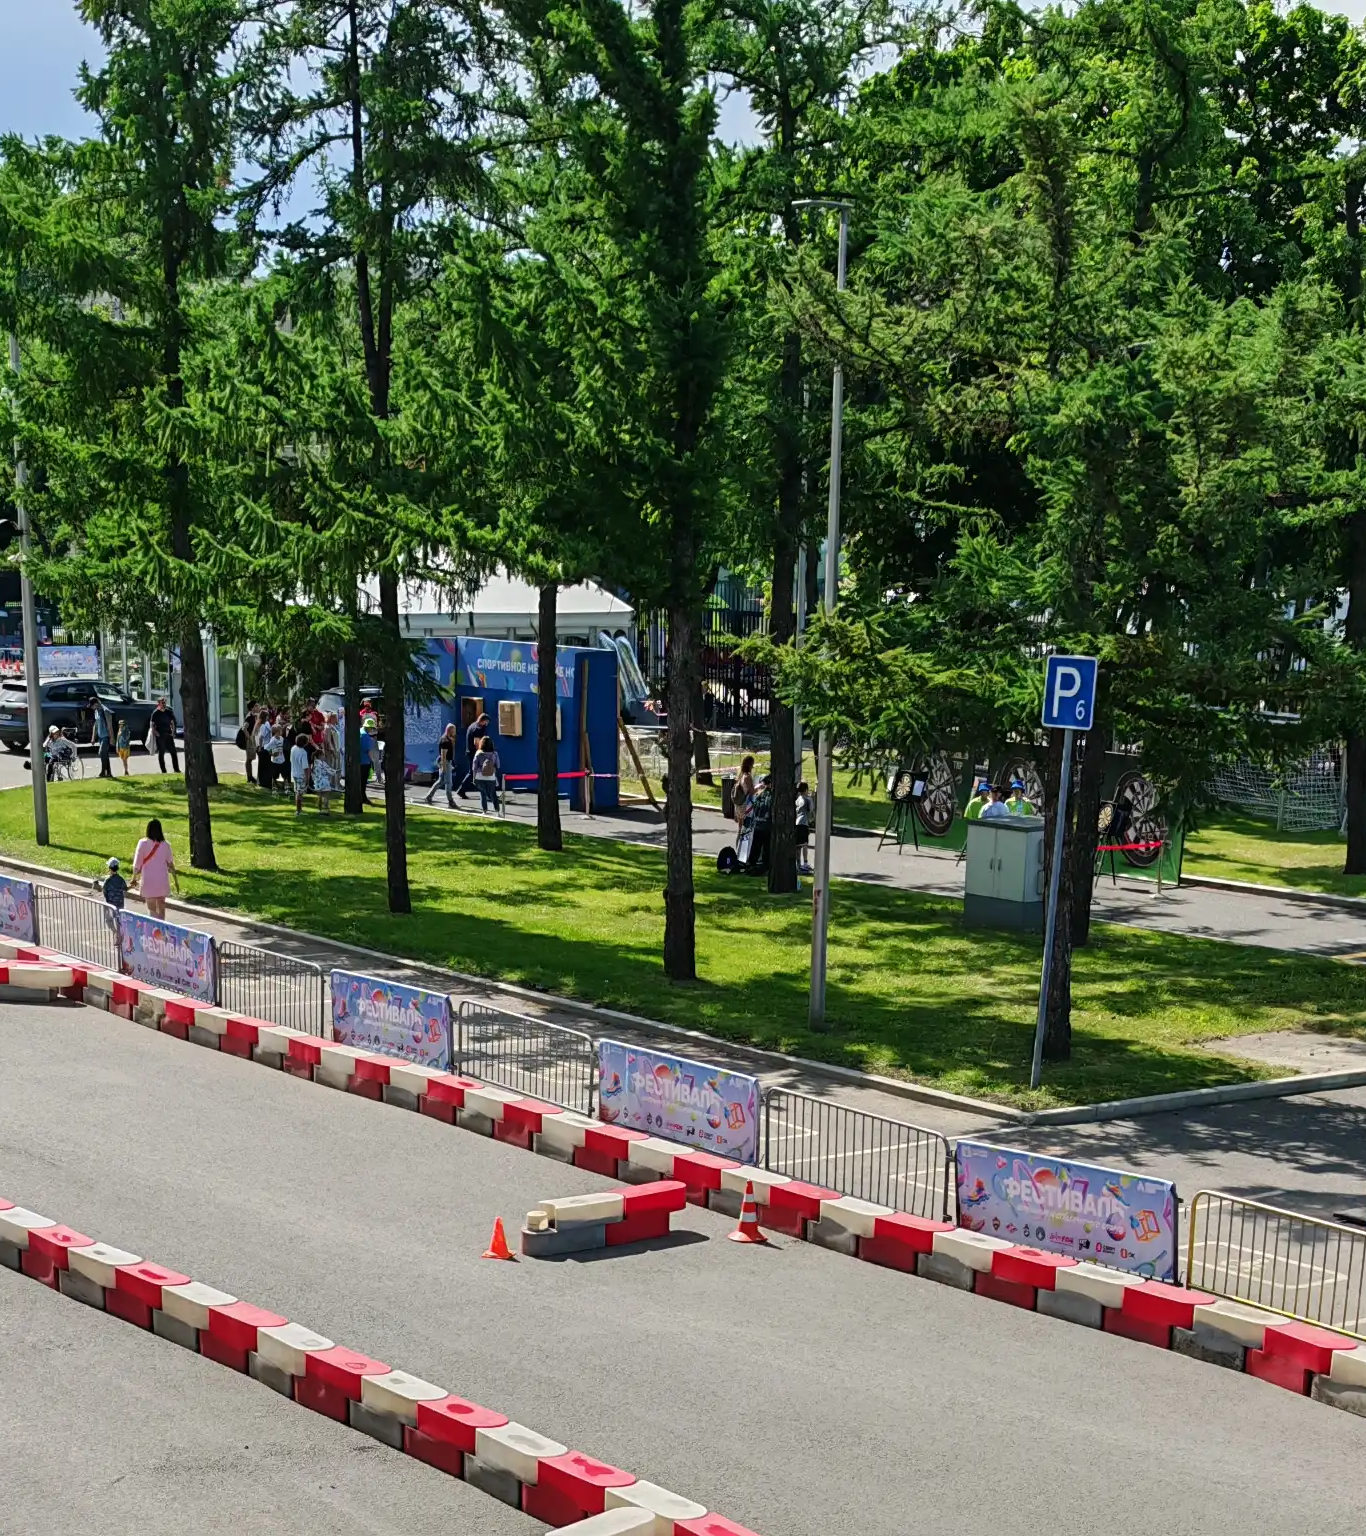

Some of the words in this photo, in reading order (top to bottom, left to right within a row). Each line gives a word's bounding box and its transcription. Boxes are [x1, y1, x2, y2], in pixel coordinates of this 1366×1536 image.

[477, 658, 527, 673] СПОРТИВНОЕ
[1052, 666, 1081, 717] P
[1075, 699, 1085, 720] 6
[1002, 1177, 1129, 1220] ФЕСТИВАЛЬ
